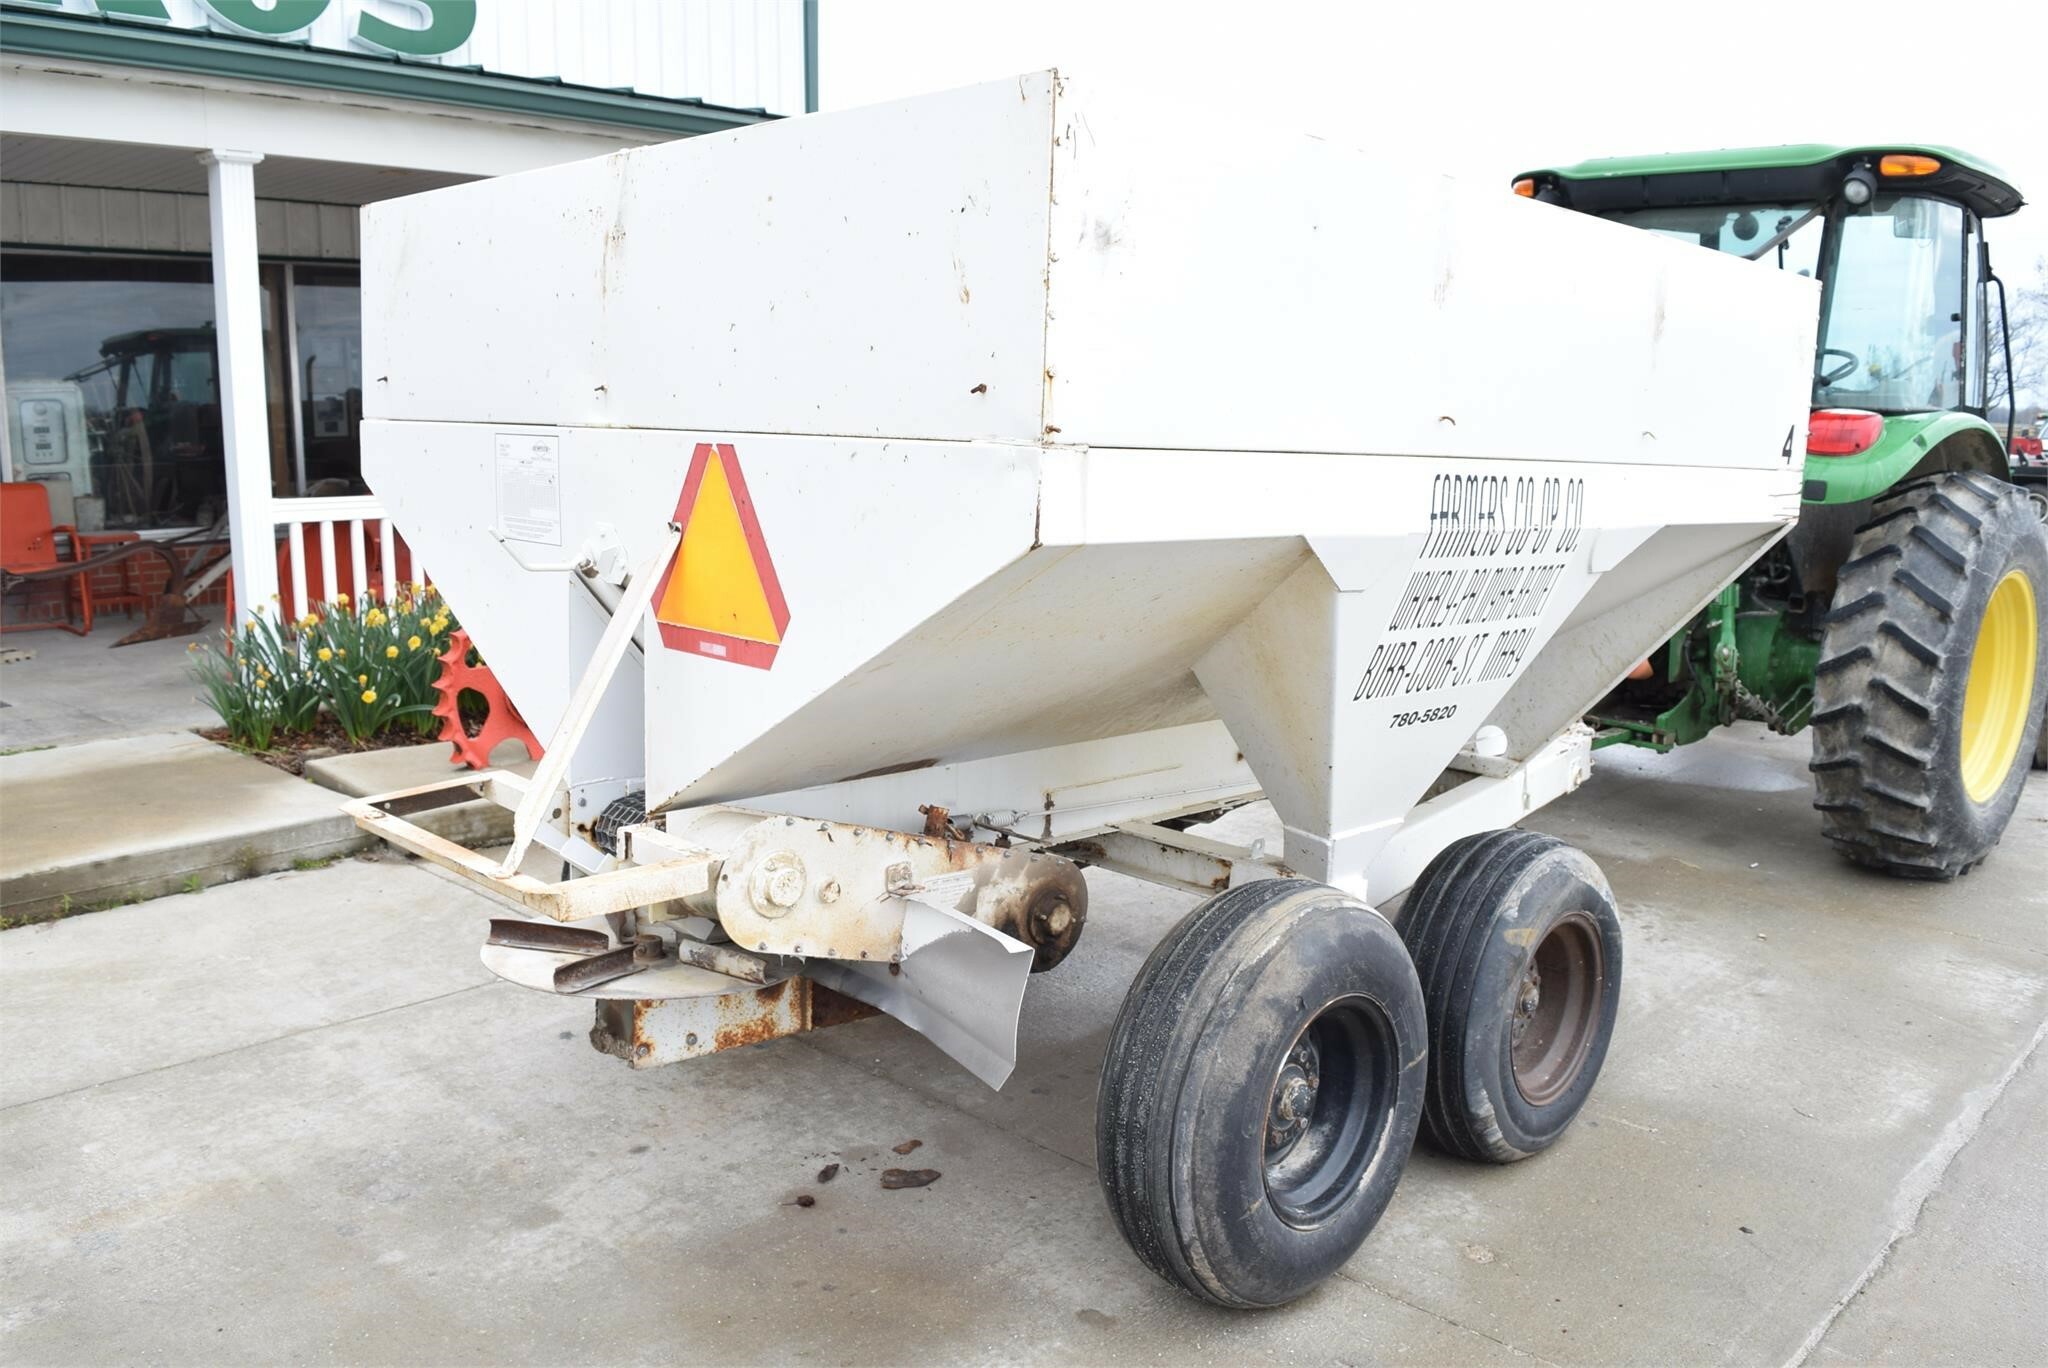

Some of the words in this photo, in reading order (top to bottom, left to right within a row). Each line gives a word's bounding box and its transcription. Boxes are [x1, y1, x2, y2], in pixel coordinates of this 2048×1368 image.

[1782, 424, 1794, 465] 4
[1419, 473, 1508, 559] FARMERS
[1505, 475, 1560, 556] CO-OP
[1476, 626, 1537, 683] MARY
[1389, 704, 1458, 729] 780-5820
